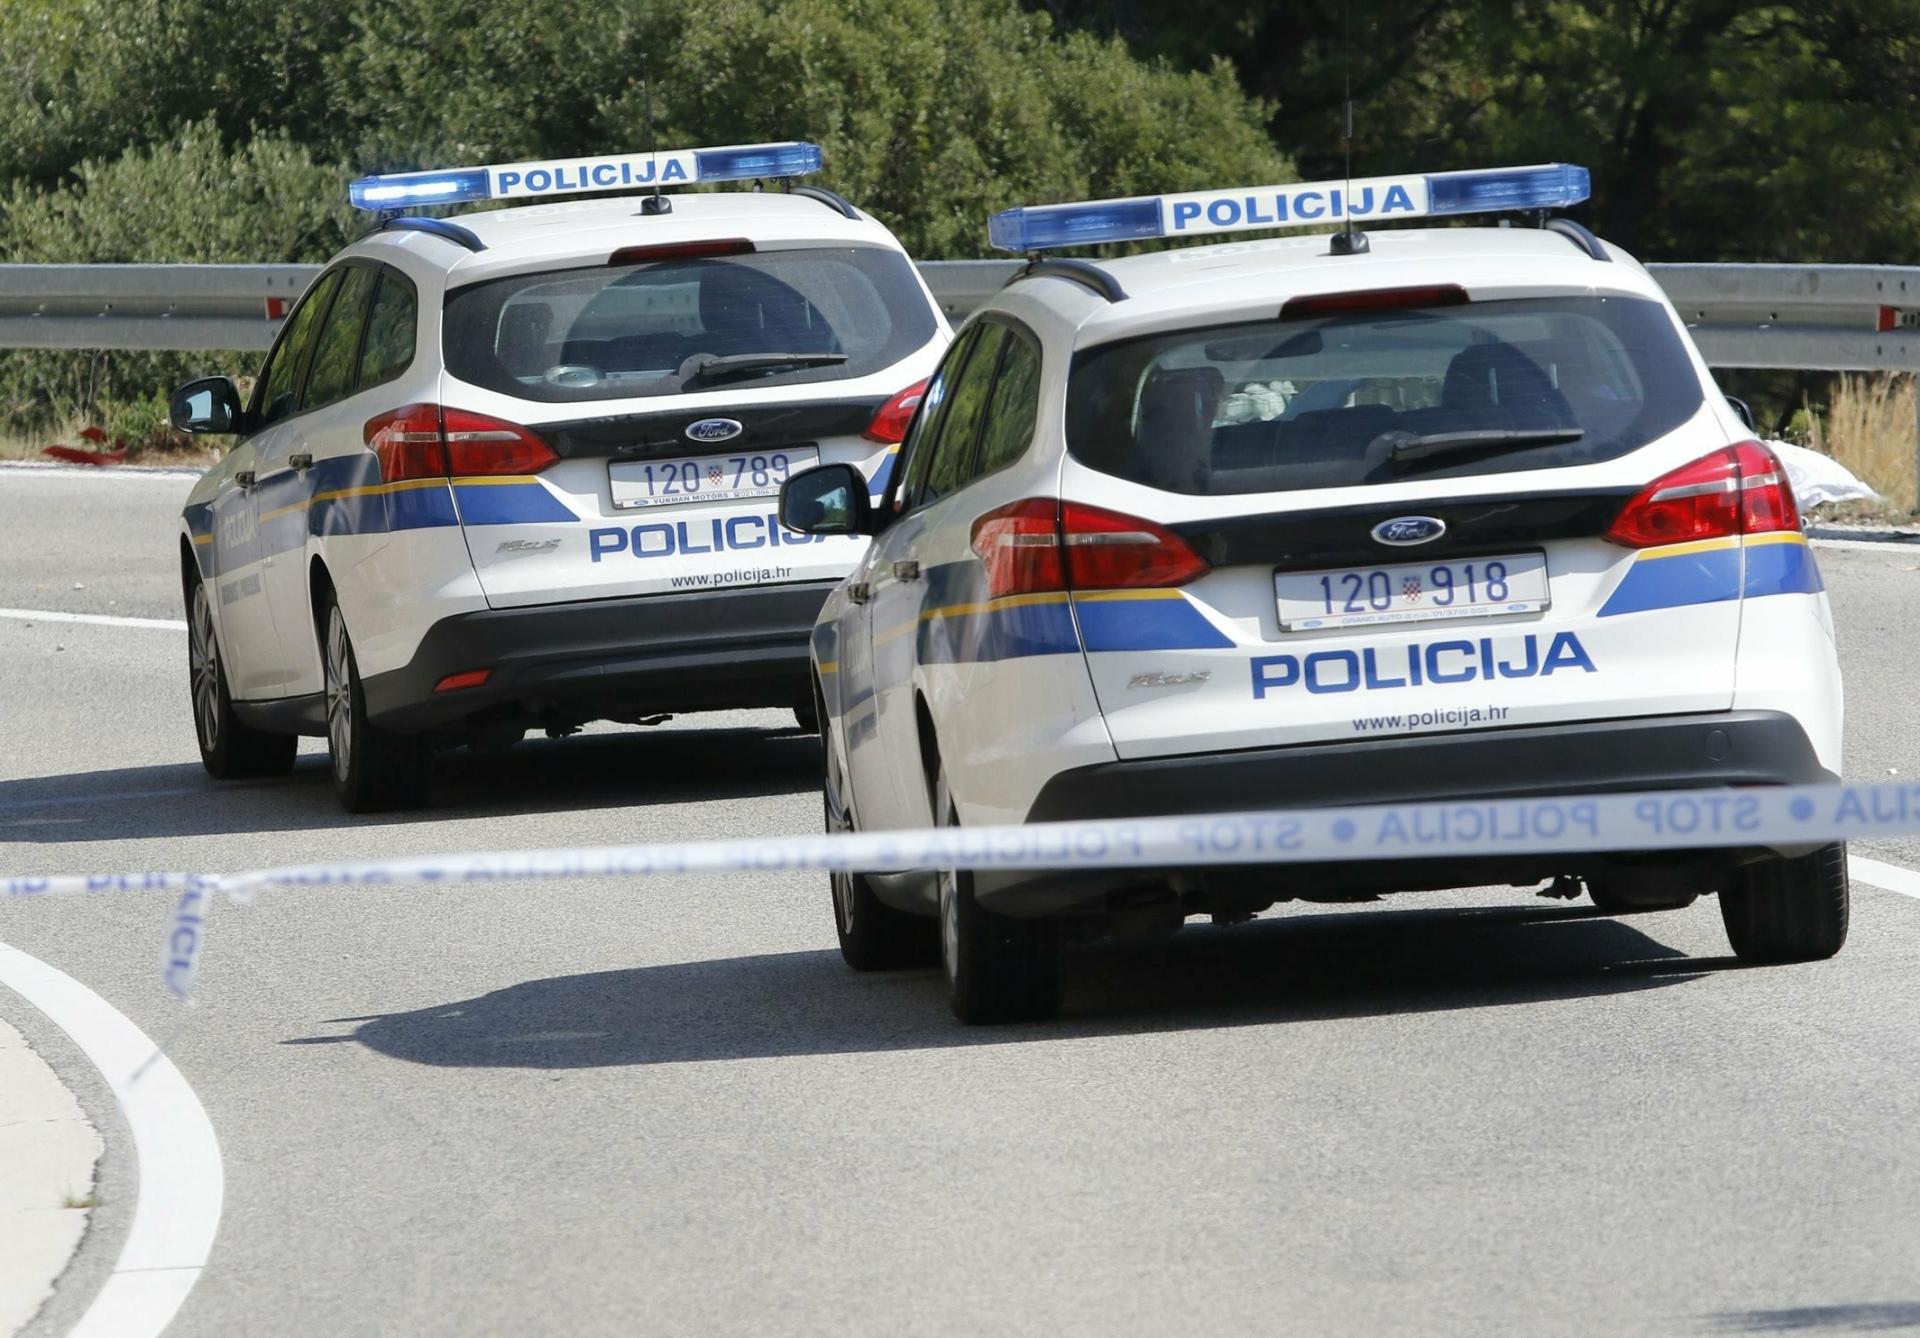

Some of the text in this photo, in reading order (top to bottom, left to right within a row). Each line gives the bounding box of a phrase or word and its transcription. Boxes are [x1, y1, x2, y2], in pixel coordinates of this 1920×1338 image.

[498, 158, 688, 194] POLICIJA
[1173, 184, 1415, 230] POLICIJA
[644, 454, 790, 496] 120 789
[653, 496, 690, 504] VUKMAN
[692, 493, 729, 501] MOTORS
[589, 513, 859, 562] POLICI
[671, 566, 791, 588] www.policija.hr
[1320, 562, 1509, 614] 120 918
[1250, 631, 1597, 699] POLICIJA
[1352, 704, 1509, 731] www.policija.hr
